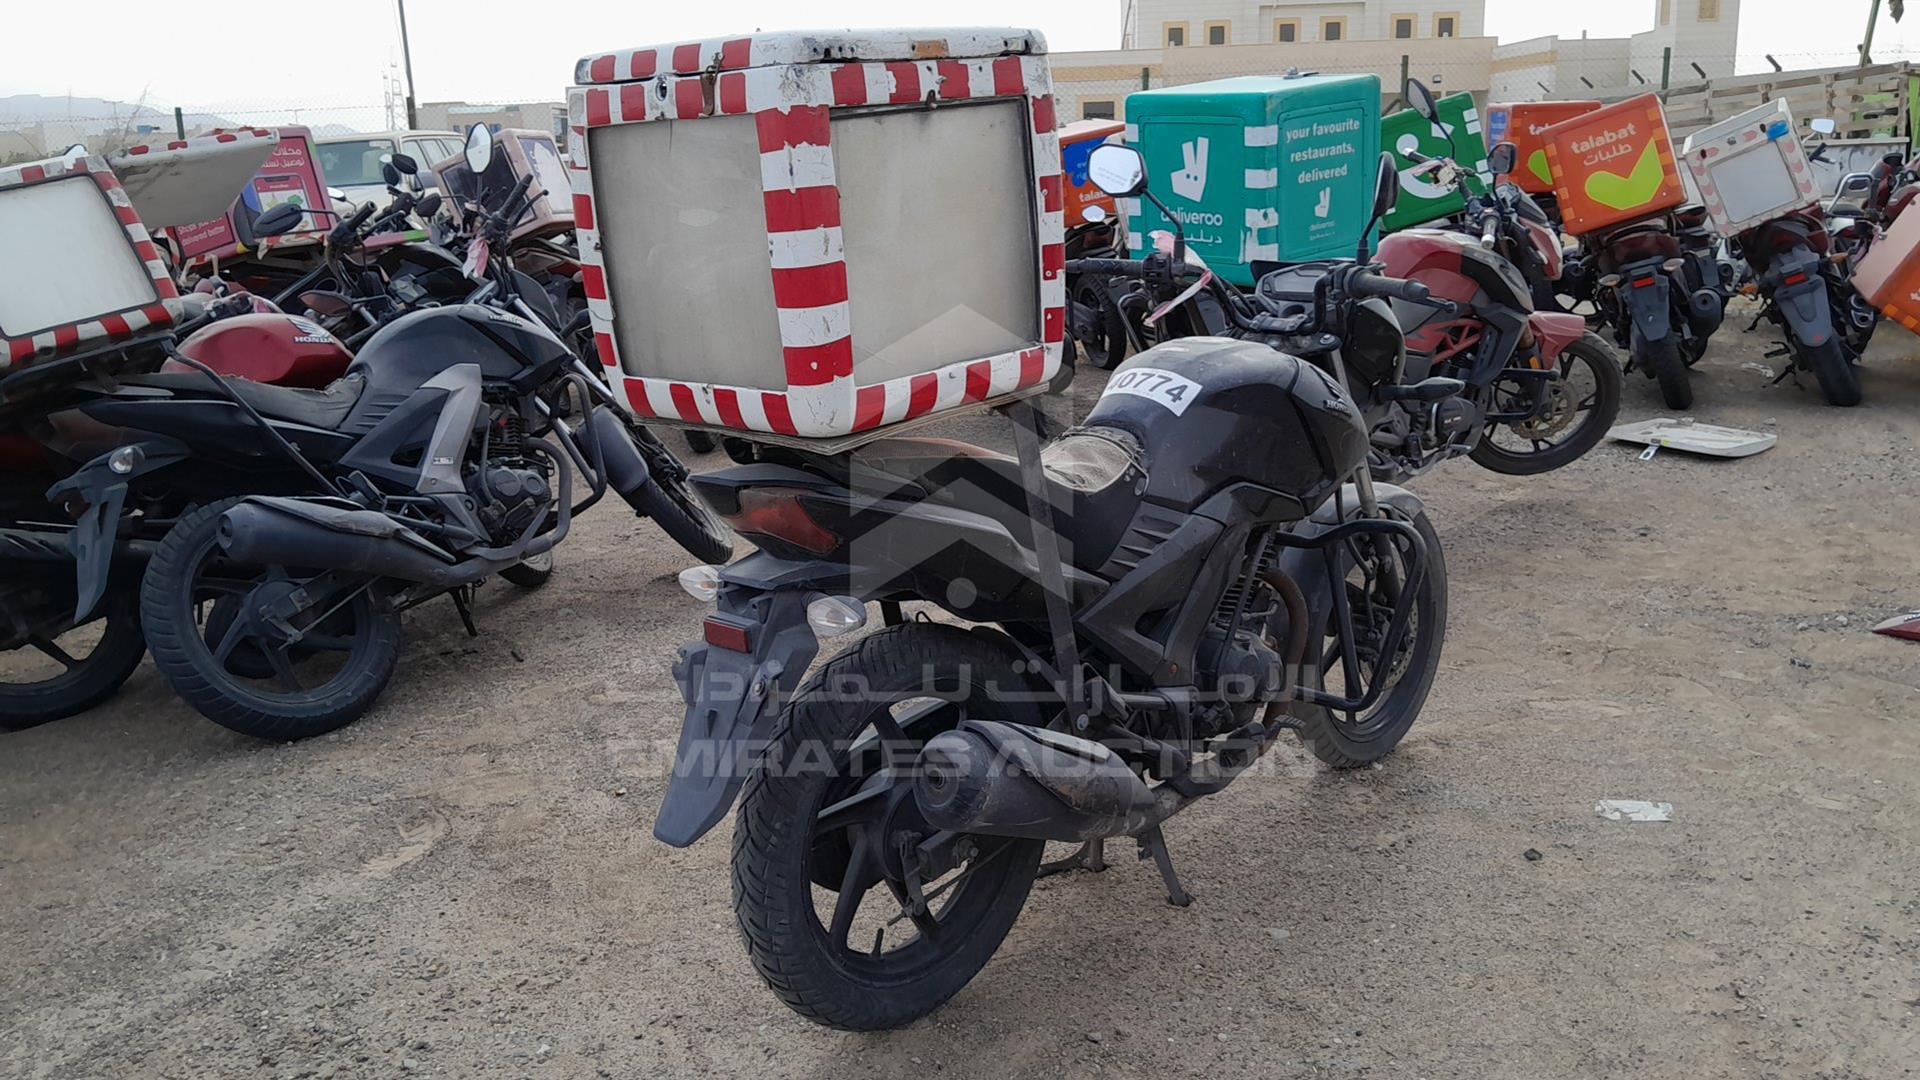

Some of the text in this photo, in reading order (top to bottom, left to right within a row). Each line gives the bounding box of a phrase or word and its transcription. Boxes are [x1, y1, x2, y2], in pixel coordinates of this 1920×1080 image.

[1286, 118, 1361, 143] your favourite
[1570, 122, 1637, 154] talabat
[1583, 143, 1633, 166] طلبات
[1298, 163, 1349, 184] delivered
[1078, 188, 1106, 203] tala
